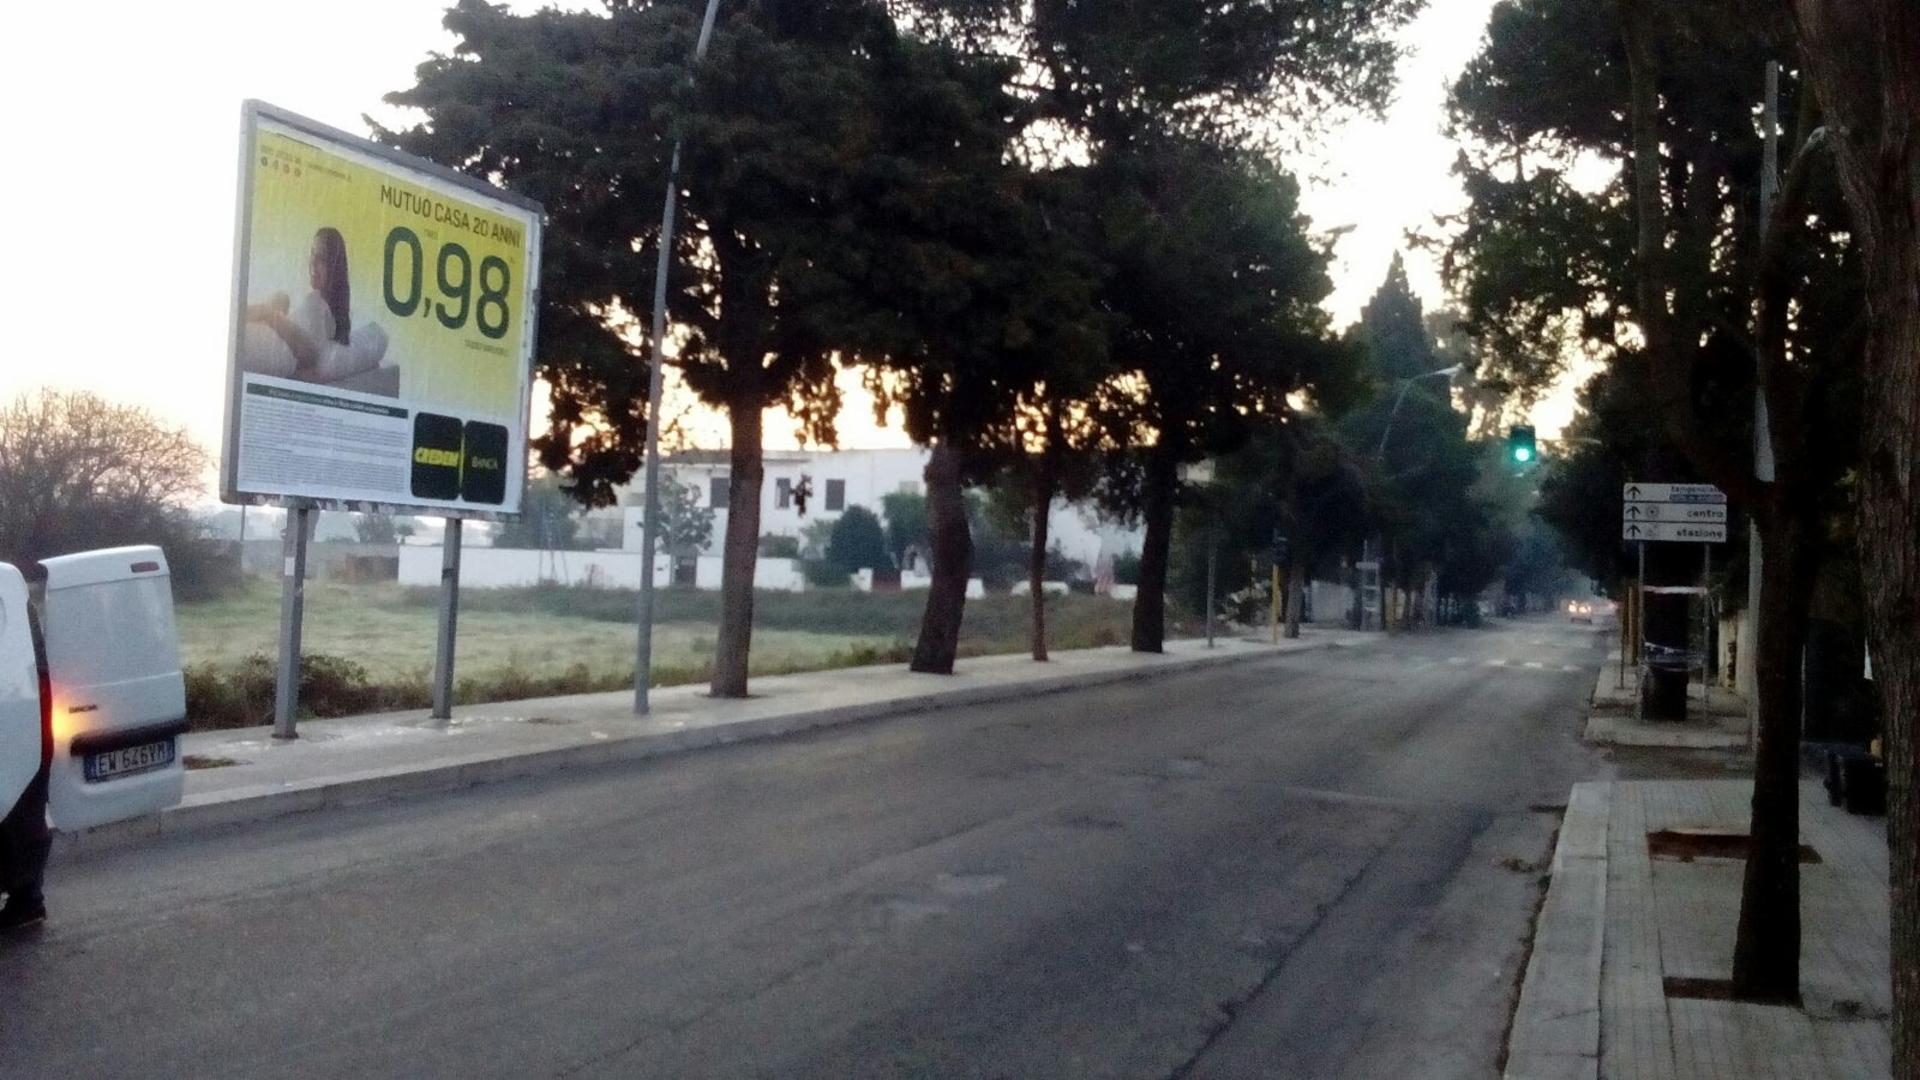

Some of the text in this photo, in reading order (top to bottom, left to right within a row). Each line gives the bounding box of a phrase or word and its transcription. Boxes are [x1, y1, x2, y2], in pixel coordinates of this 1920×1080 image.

[380, 185, 520, 248] MUTUO CASA 20 ANNI
[383, 226, 511, 339] 0,98
[1687, 509, 1724, 518] centro
[1676, 528, 1723, 538] stazione
